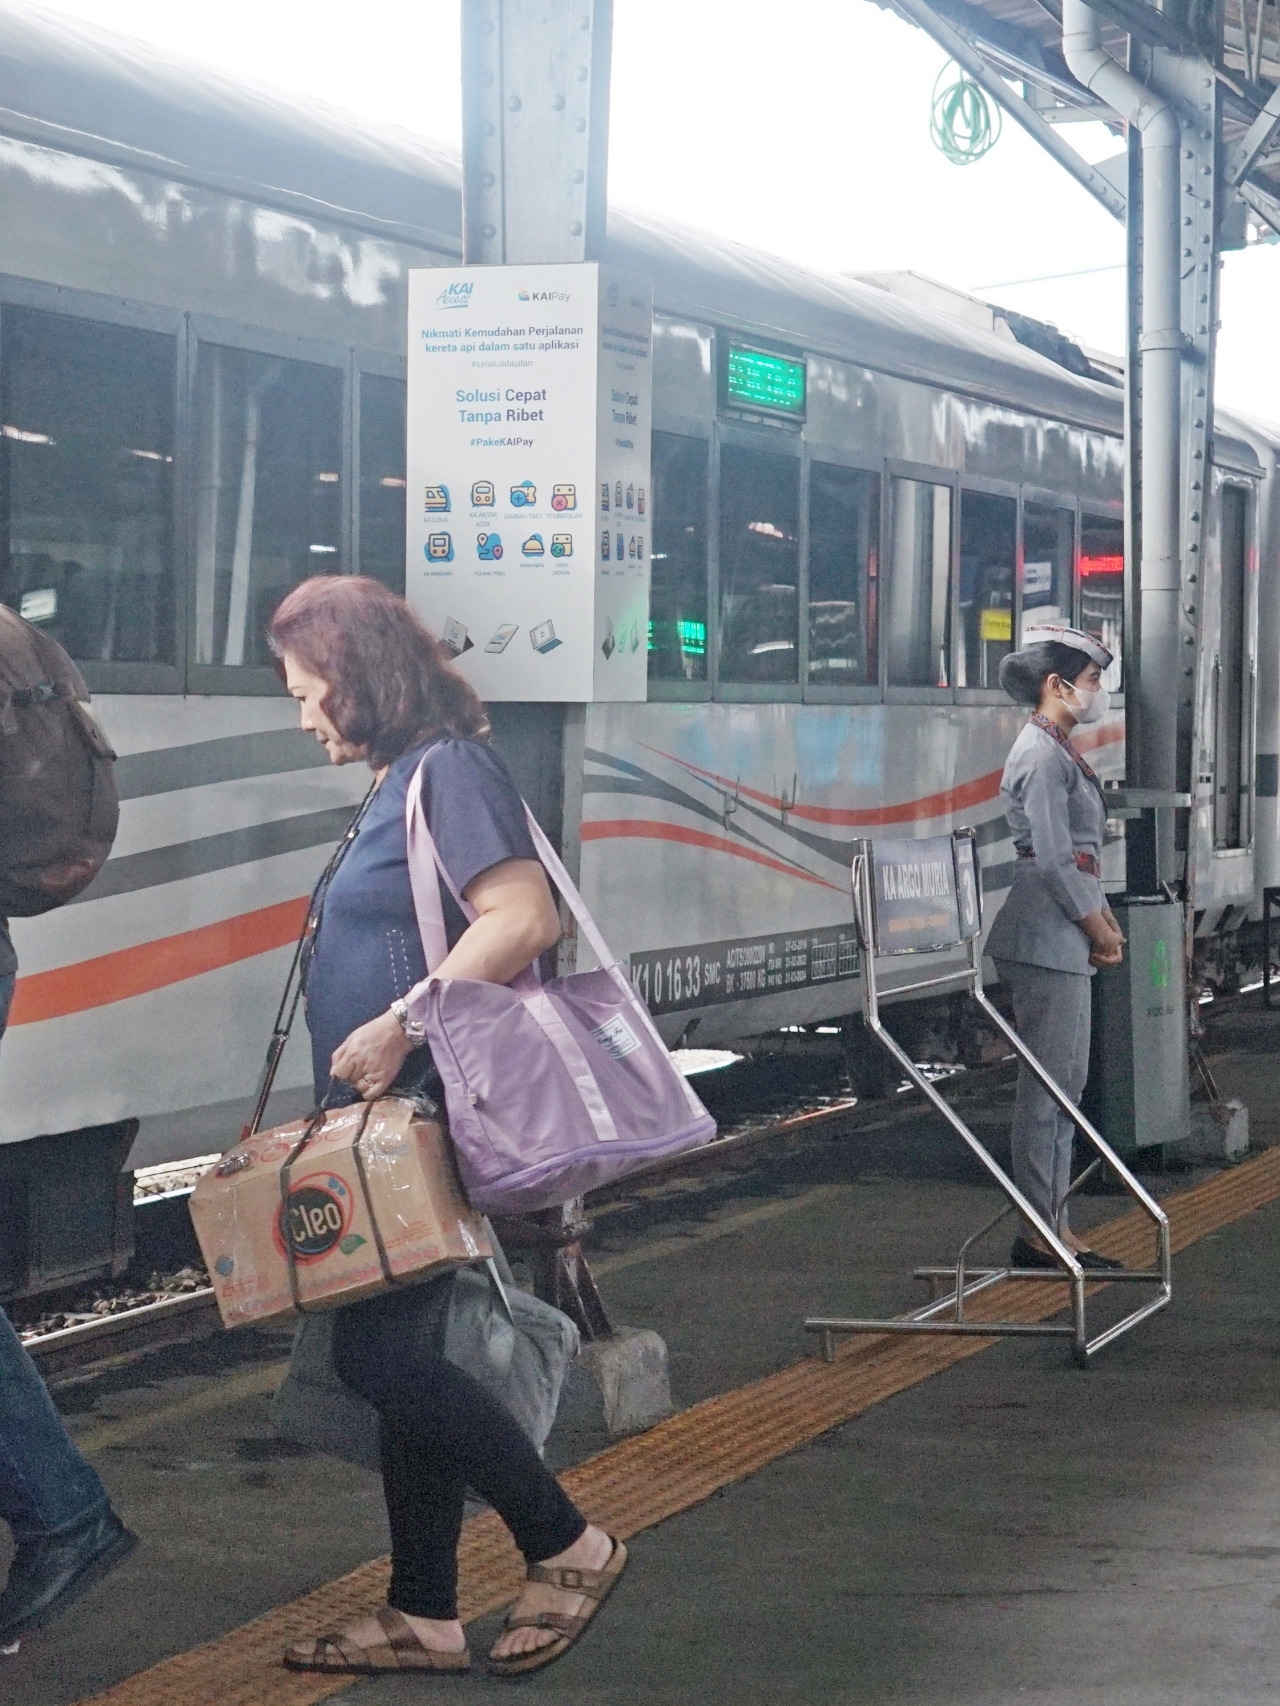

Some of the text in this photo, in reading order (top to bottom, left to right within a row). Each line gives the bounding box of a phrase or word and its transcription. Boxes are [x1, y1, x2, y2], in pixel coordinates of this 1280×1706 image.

[435, 288, 471, 305] Access
[448, 283, 474, 295] KAI
[532, 291, 571, 302] KAIPay
[421, 325, 584, 339] Nikmati Kemudahan Perjalanan
[425, 340, 579, 354] kereta api dalam satu aplikasi
[456, 388, 547, 405] Solusi Cepat
[458, 408, 544, 425] Tanpa Ribet
[470, 437, 534, 448] #PakeKAIPay
[882, 861, 950, 900] KA ARGO MURIA
[963, 869, 974, 925] 3
[654, 961, 663, 1004] 0
[666, 958, 682, 1001] 16
[685, 955, 701, 998] 33
[704, 961, 721, 986] SMC
[291, 1203, 341, 1242] Cleo
